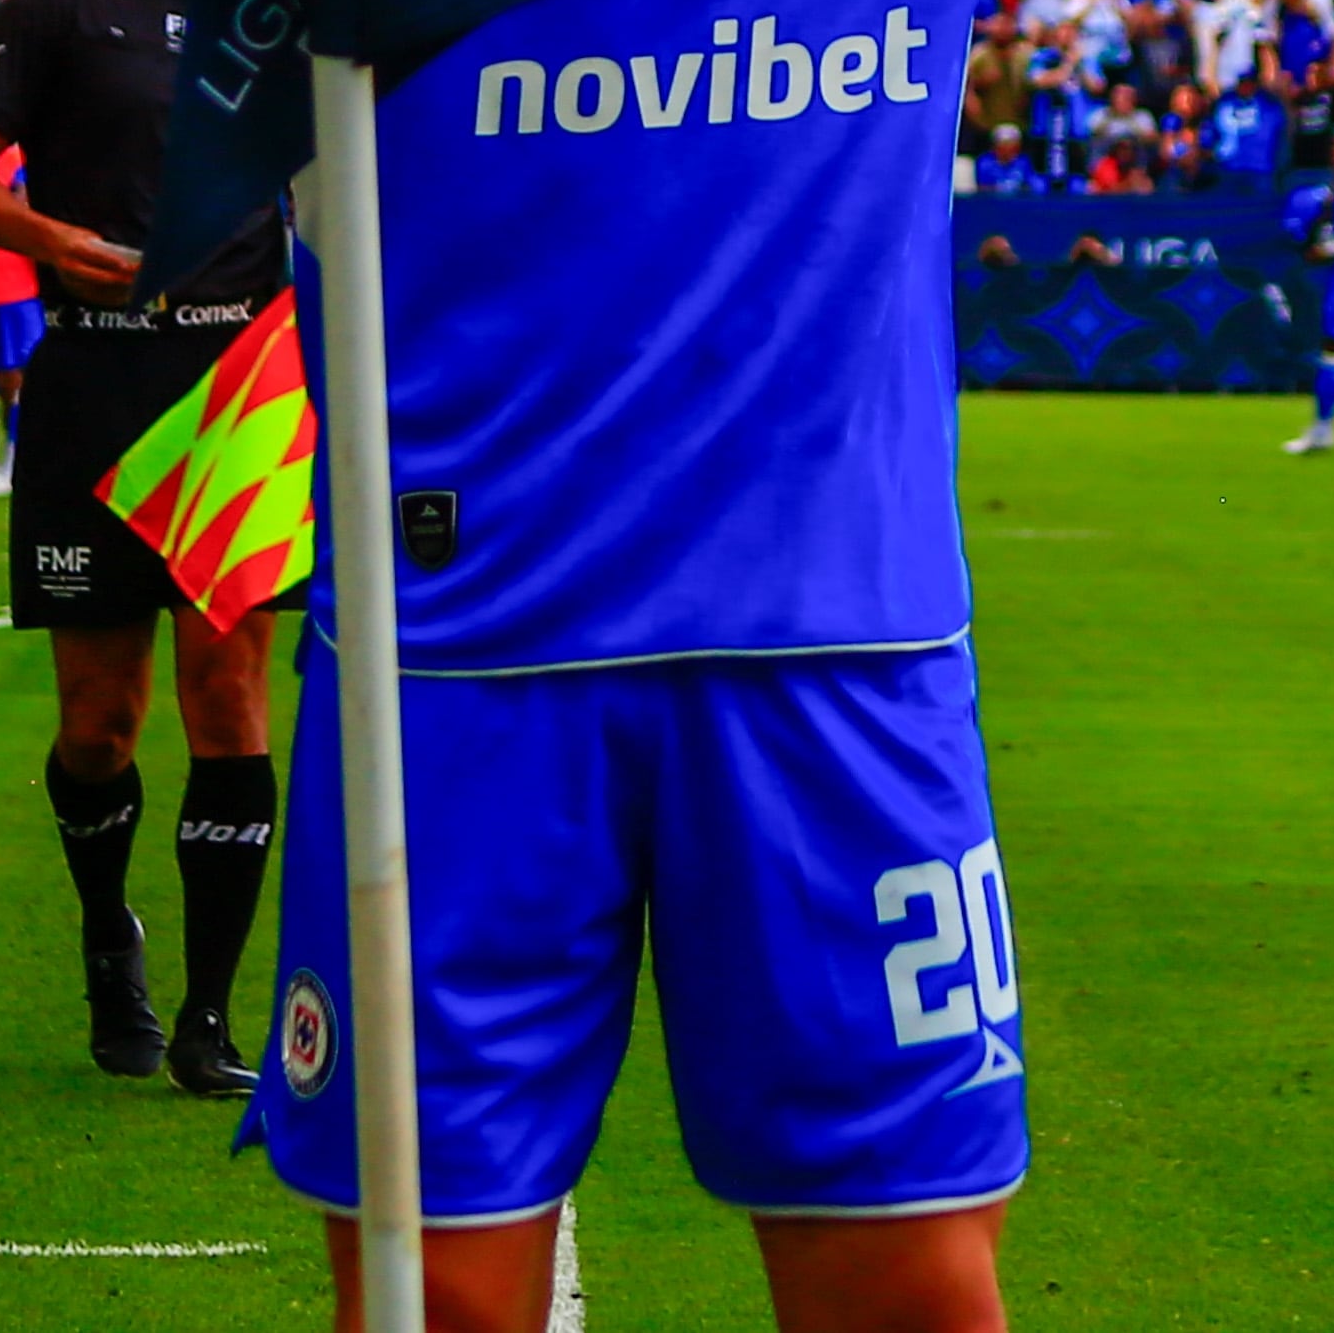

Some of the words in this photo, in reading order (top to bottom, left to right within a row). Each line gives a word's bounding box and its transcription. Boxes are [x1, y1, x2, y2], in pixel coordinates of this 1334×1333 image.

[474, 5, 929, 137] novibet
[174, 297, 254, 327] Comex
[35, 545, 92, 573] FMF
[873, 836, 1019, 1048] 20
